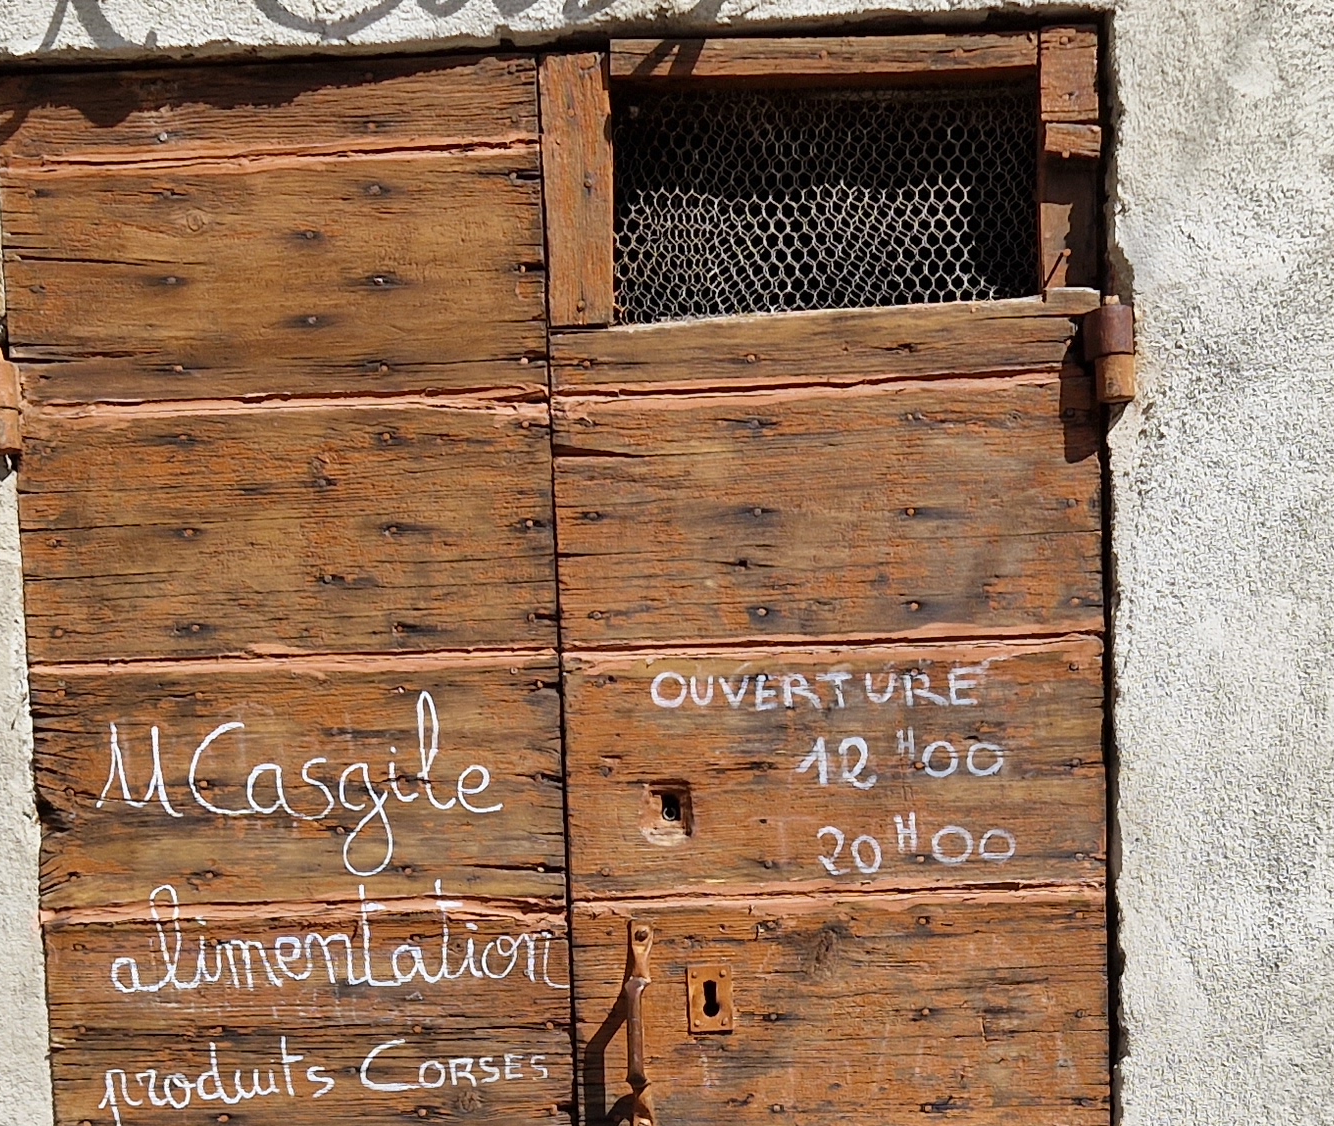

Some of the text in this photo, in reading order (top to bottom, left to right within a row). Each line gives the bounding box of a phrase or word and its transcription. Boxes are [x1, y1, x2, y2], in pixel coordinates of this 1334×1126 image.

[650, 667, 979, 710] OUVERTURE
[188, 690, 504, 877] Casgile
[111, 879, 571, 994] alimentation
[360, 1039, 549, 1092] CORSES
